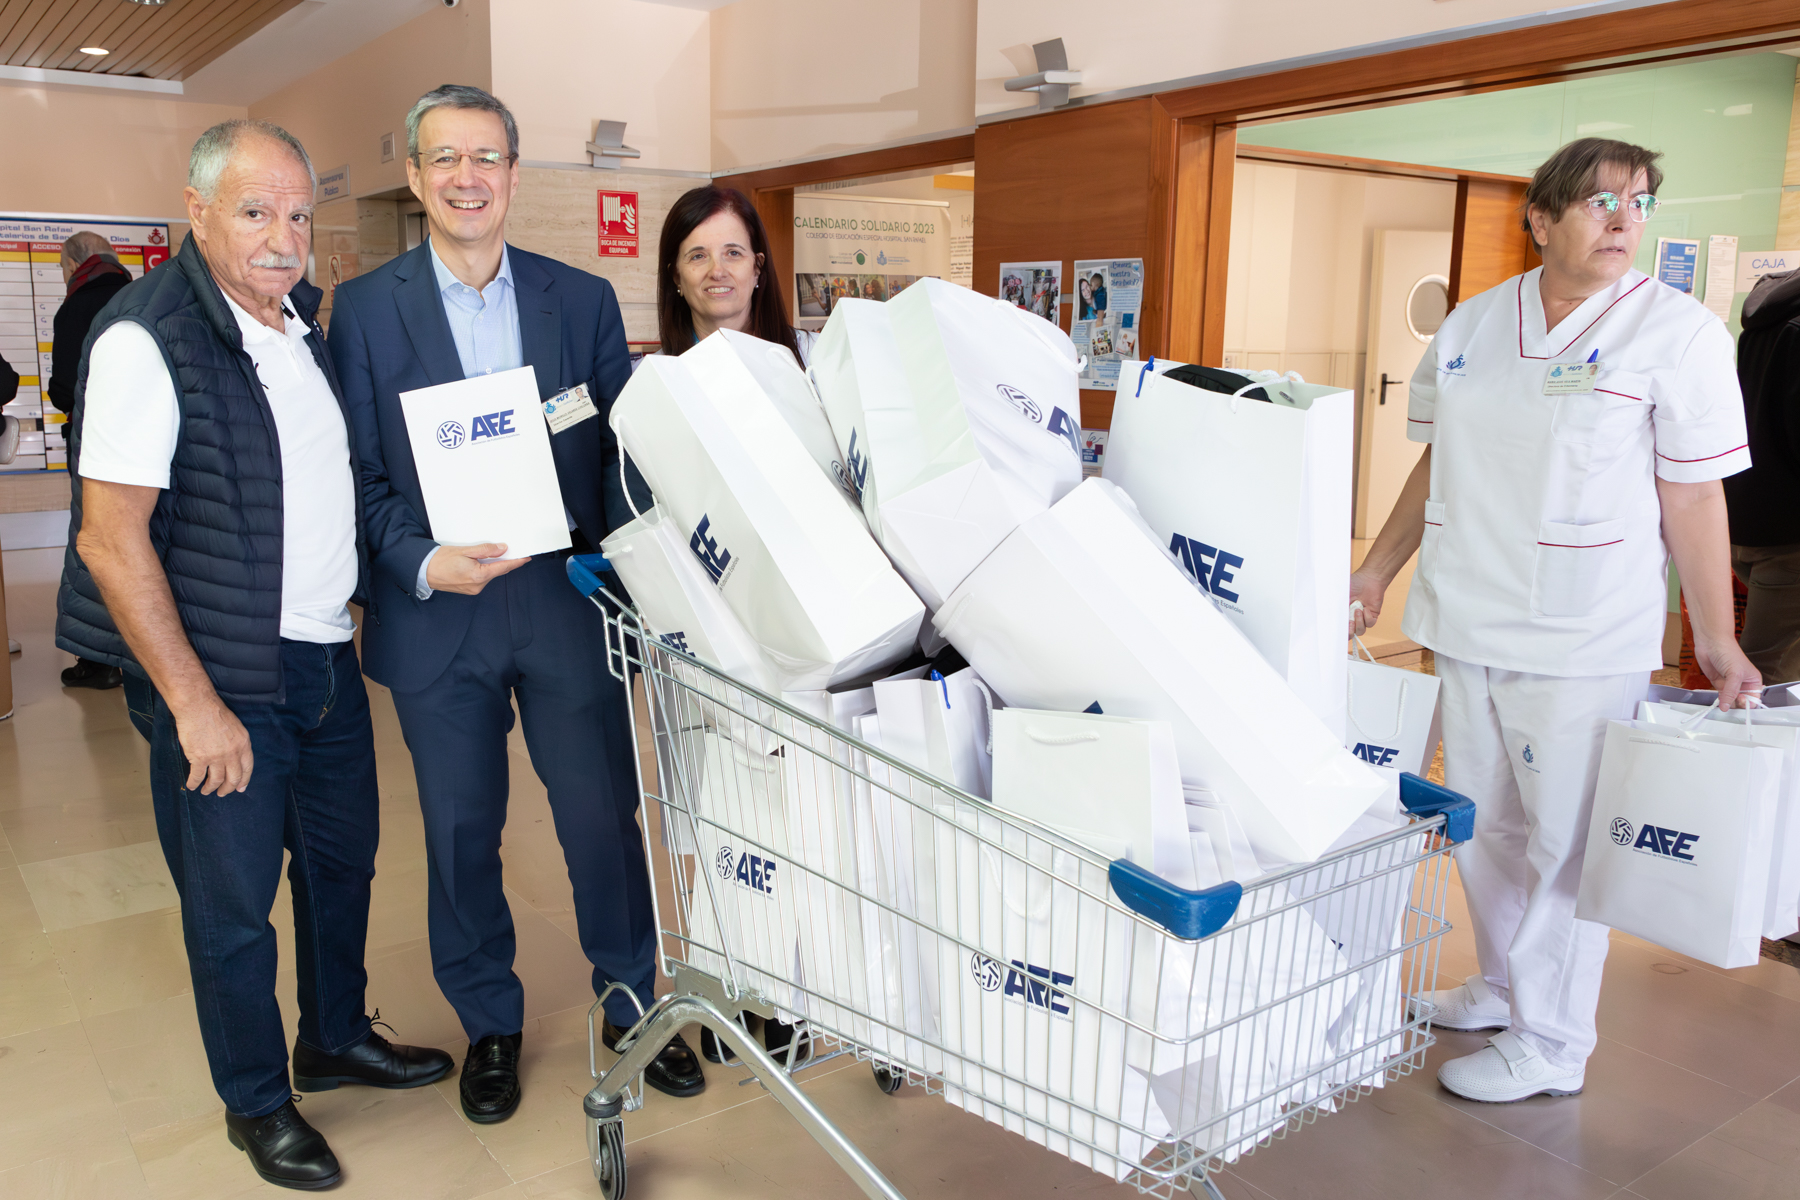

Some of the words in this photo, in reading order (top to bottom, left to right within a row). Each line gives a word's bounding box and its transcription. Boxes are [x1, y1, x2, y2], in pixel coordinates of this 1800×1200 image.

[794, 216, 858, 230] CALENDARIO
[861, 220, 910, 233] SOLIDARIO
[913, 222, 935, 234] 2023
[110, 235, 130, 243] Dios
[1751, 258, 1786, 269] CAJA
[471, 409, 516, 442] AFE
[1633, 824, 1700, 861] AFE
[733, 852, 776, 894] AFE
